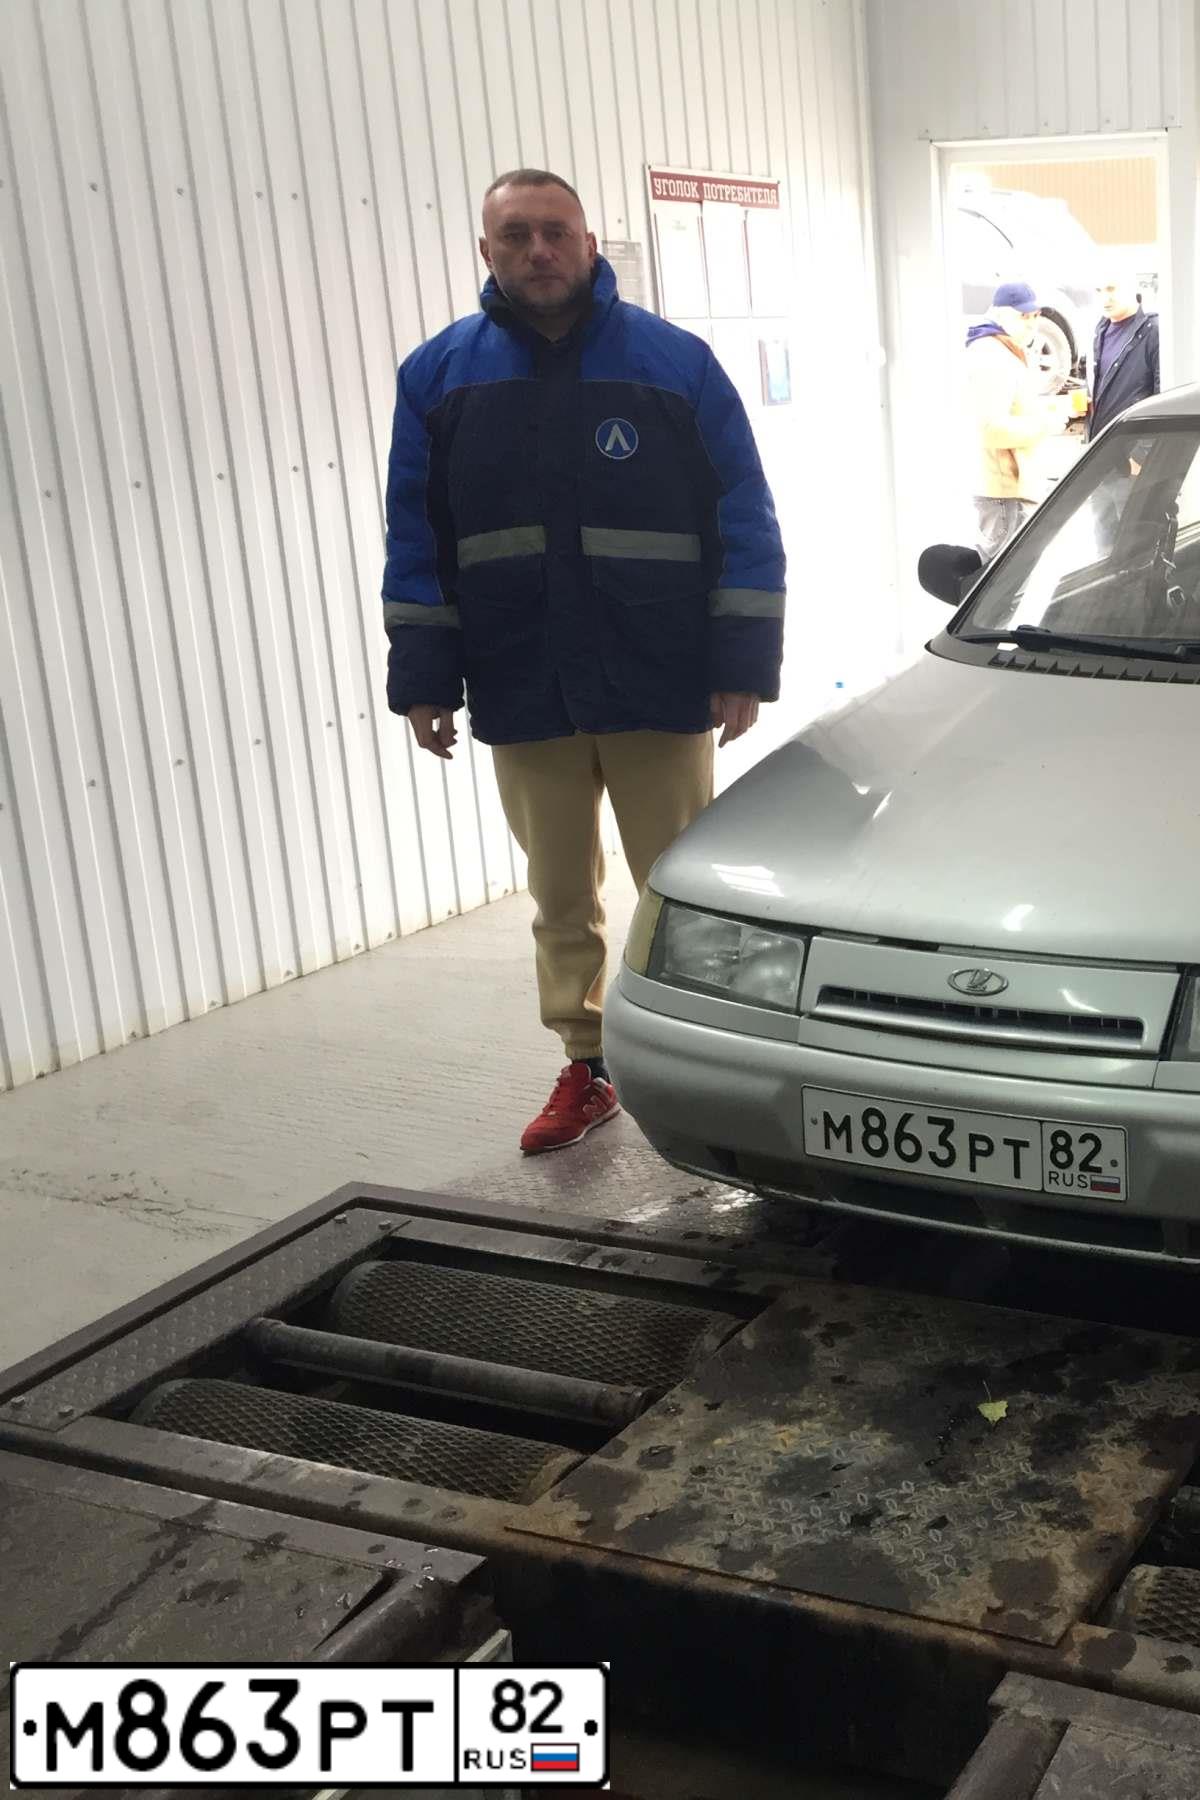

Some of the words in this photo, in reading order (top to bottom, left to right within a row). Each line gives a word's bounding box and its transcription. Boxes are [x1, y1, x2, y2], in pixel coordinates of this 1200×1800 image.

[654, 178, 699, 198] УГОЛОК
[703, 183, 778, 204] ПОТРЕБИТЕЛЯ
[1050, 1130, 1103, 1174] 82
[1048, 1171, 1089, 1189] RUS
